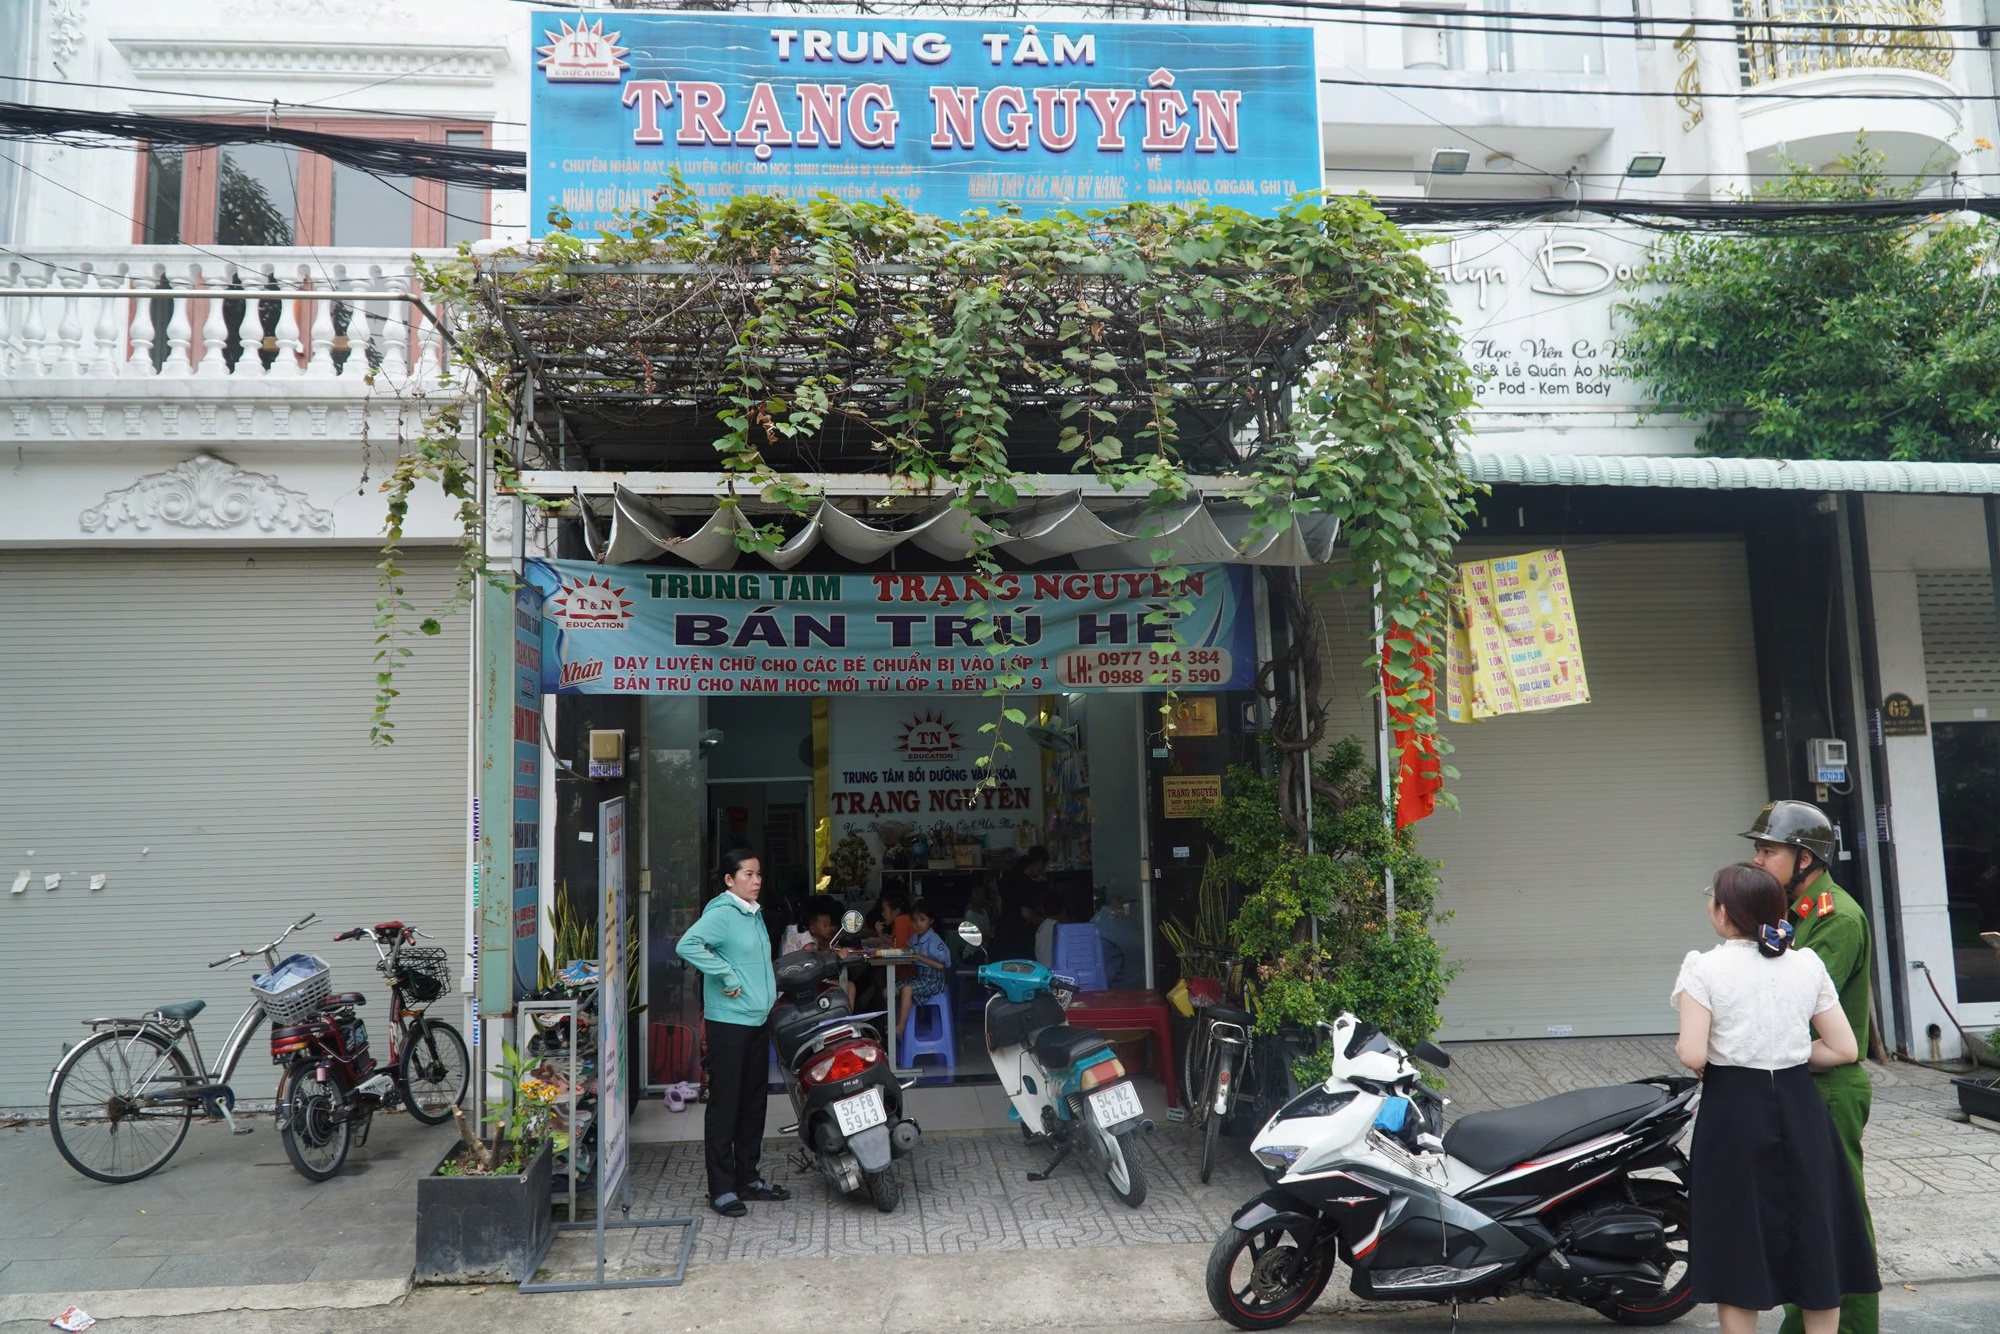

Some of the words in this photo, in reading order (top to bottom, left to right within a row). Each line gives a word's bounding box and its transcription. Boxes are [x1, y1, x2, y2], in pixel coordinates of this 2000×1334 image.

[569, 42, 598, 57] TN
[770, 29, 952, 64] TRUNG
[983, 24, 1096, 65] TÂM
[621, 80, 899, 160] TRẠNG
[930, 67, 1242, 152] NGUYÊN
[562, 156, 607, 173] CHUYÊN
[746, 162, 768, 175] CHO
[1175, 179, 1213, 196] PIANO,
[1214, 179, 1259, 196] ORGAN,
[1260, 180, 1281, 195] GHI
[1471, 339, 1512, 362] Học
[1520, 338, 1564, 358] Viên
[1490, 364, 1499, 377] &
[1505, 361, 1522, 377] Lẻ
[1527, 362, 1567, 378] Quần
[1574, 361, 1593, 377] Áo
[1499, 381, 1525, 395] Pod
[1540, 382, 1570, 395] Kem
[1576, 382, 1611, 397] Body
[1543, 551, 1560, 563] 10K
[1470, 564, 1486, 576] 10K
[1547, 566, 1564, 578] 10K
[646, 573, 761, 600] TRUNG
[871, 573, 1022, 607] TRẠNG
[1472, 580, 1488, 592] 10K
[1552, 581, 1566, 592] 10K
[576, 598, 587, 610] T
[600, 599, 613, 611] N
[1475, 595, 1490, 606] 10K
[1560, 596, 1569, 607] 7K
[1479, 610, 1493, 621] 10K
[565, 621, 625, 629] EDUCATION
[674, 605, 847, 648] BÁN
[875, 605, 1043, 648] TRÚ
[1078, 602, 1182, 645] HÈ
[1482, 625, 1496, 637] 10K
[1485, 640, 1500, 652] 10K
[613, 655, 649, 673] DẠY
[655, 653, 714, 676] LUYỆN
[718, 654, 757, 673] CHỮ
[761, 658, 798, 673] CHO
[802, 654, 839, 673] CÁC
[843, 655, 867, 673] BÉ
[873, 652, 932, 673] CHUẨN
[937, 658, 955, 675] BỊ
[960, 654, 995, 672] VÀO
[1040, 656, 1049, 670] 1
[1067, 655, 1093, 685] LH:
[1097, 651, 1142, 667] 0977
[1187, 650, 1221, 665] 384
[1488, 655, 1504, 667] 10K
[613, 673, 650, 691] BÁN
[656, 674, 692, 692] TRÚ
[698, 677, 734, 692] CHO
[740, 675, 779, 693] NĂM
[784, 677, 821, 695] HỌC
[827, 675, 860, 693] MỚI
[866, 674, 890, 692] TỪ
[895, 673, 930, 692] LỚP
[936, 678, 945, 691] 1
[951, 672, 988, 691] ĐẾN
[1031, 677, 1043, 690] 9
[1099, 669, 1144, 684] 0988
[1187, 669, 1221, 683] 590
[1491, 670, 1507, 682] 10K
[1495, 685, 1511, 697] 10K
[1176, 700, 1203, 721] 61
[1498, 700, 1515, 712] 10K
[1888, 700, 1911, 717] 65
[916, 731, 942, 746] TN
[843, 770, 878, 784] TRUNG
[882, 767, 904, 783] TÂM
[908, 766, 925, 782] BỒI
[929, 766, 967, 782] DƯỠNG
[832, 790, 921, 818] TRẠNG
[928, 782, 1032, 812] NGUYÊN
[1168, 788, 1190, 799] TRẠNG
[1191, 786, 1218, 798] NGUYÊN
[840, 1093, 875, 1117] 52-F8
[1096, 1086, 1130, 1109] 54-N2
[1102, 1100, 1137, 1123] 9442
[845, 1108, 880, 1132] 5943
